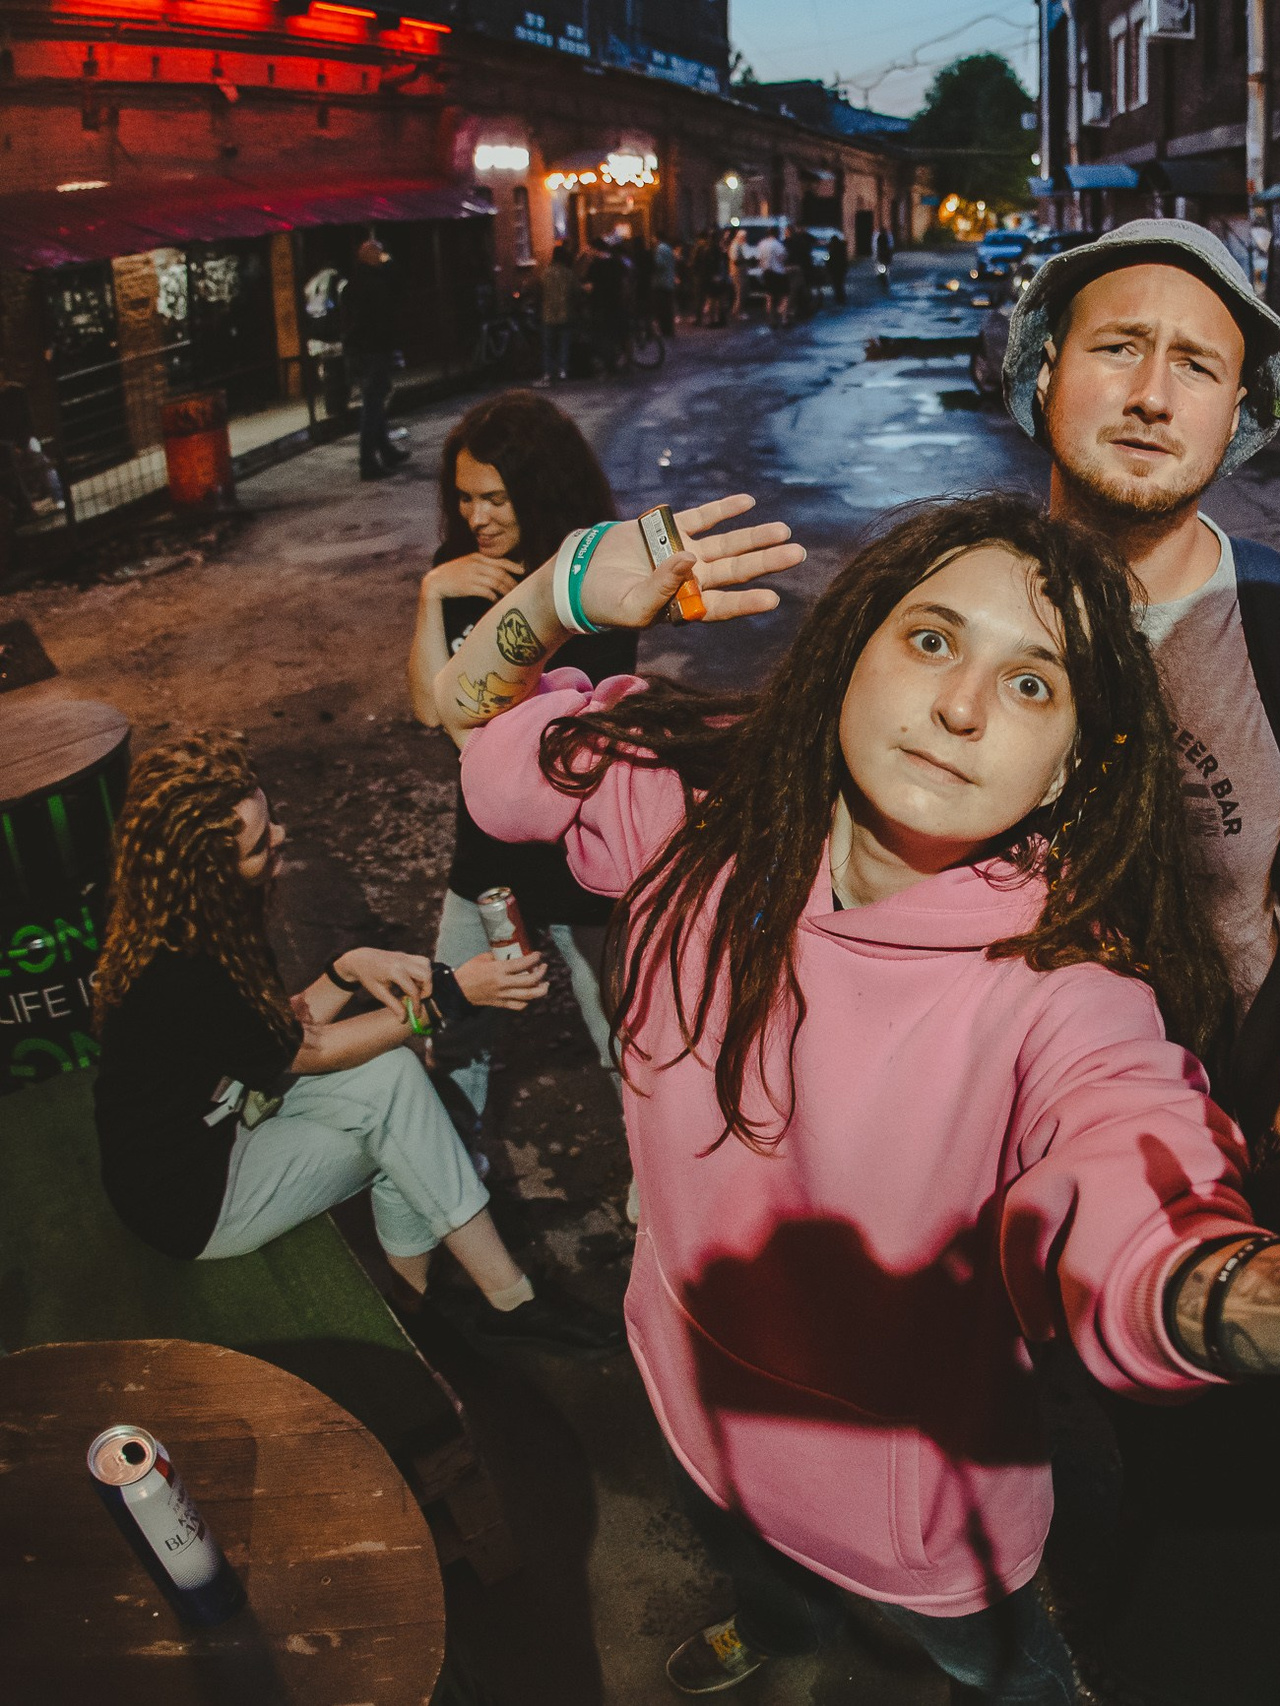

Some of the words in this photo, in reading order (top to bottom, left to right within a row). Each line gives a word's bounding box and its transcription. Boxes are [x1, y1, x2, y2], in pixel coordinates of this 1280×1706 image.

[1171, 722, 1218, 779] EER
[1211, 778, 1242, 837] BAR
[0, 905, 99, 978] ON
